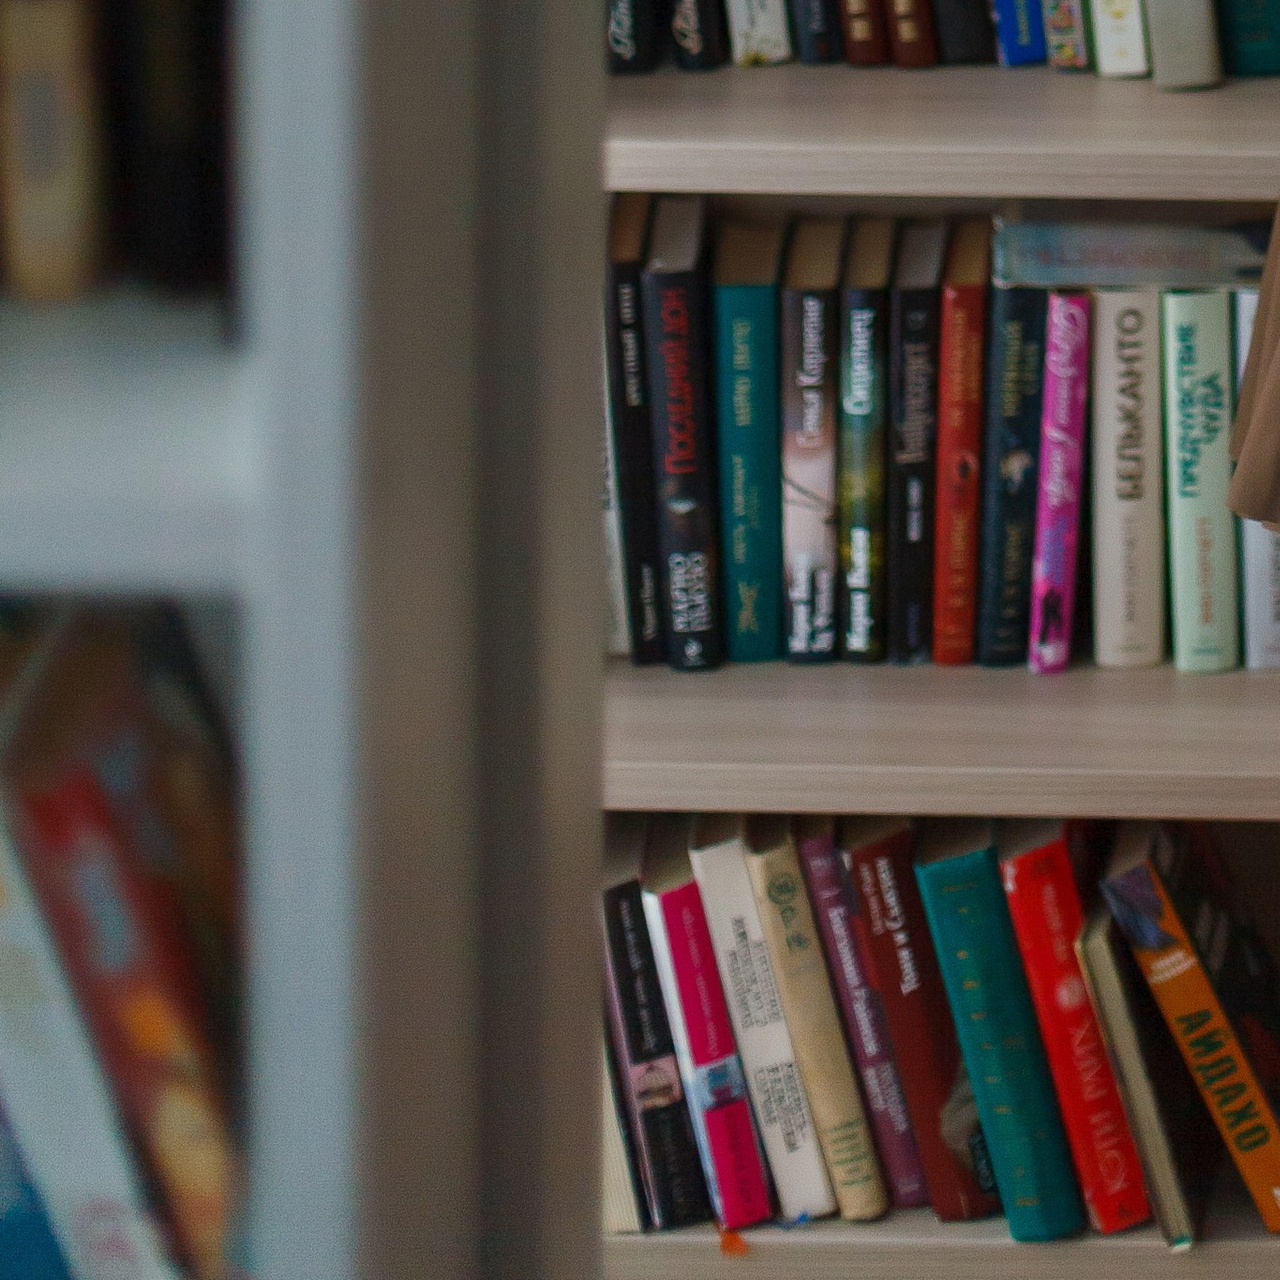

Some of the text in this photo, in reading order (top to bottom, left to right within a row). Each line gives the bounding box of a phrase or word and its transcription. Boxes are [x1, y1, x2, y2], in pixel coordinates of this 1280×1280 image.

[1114, 308, 1145, 502] БЕЛЬКАНТО
[1176, 324, 1200, 498] ПРЕДЧУВСТВИЕ
[1201, 373, 1225, 444] ЧУДА
